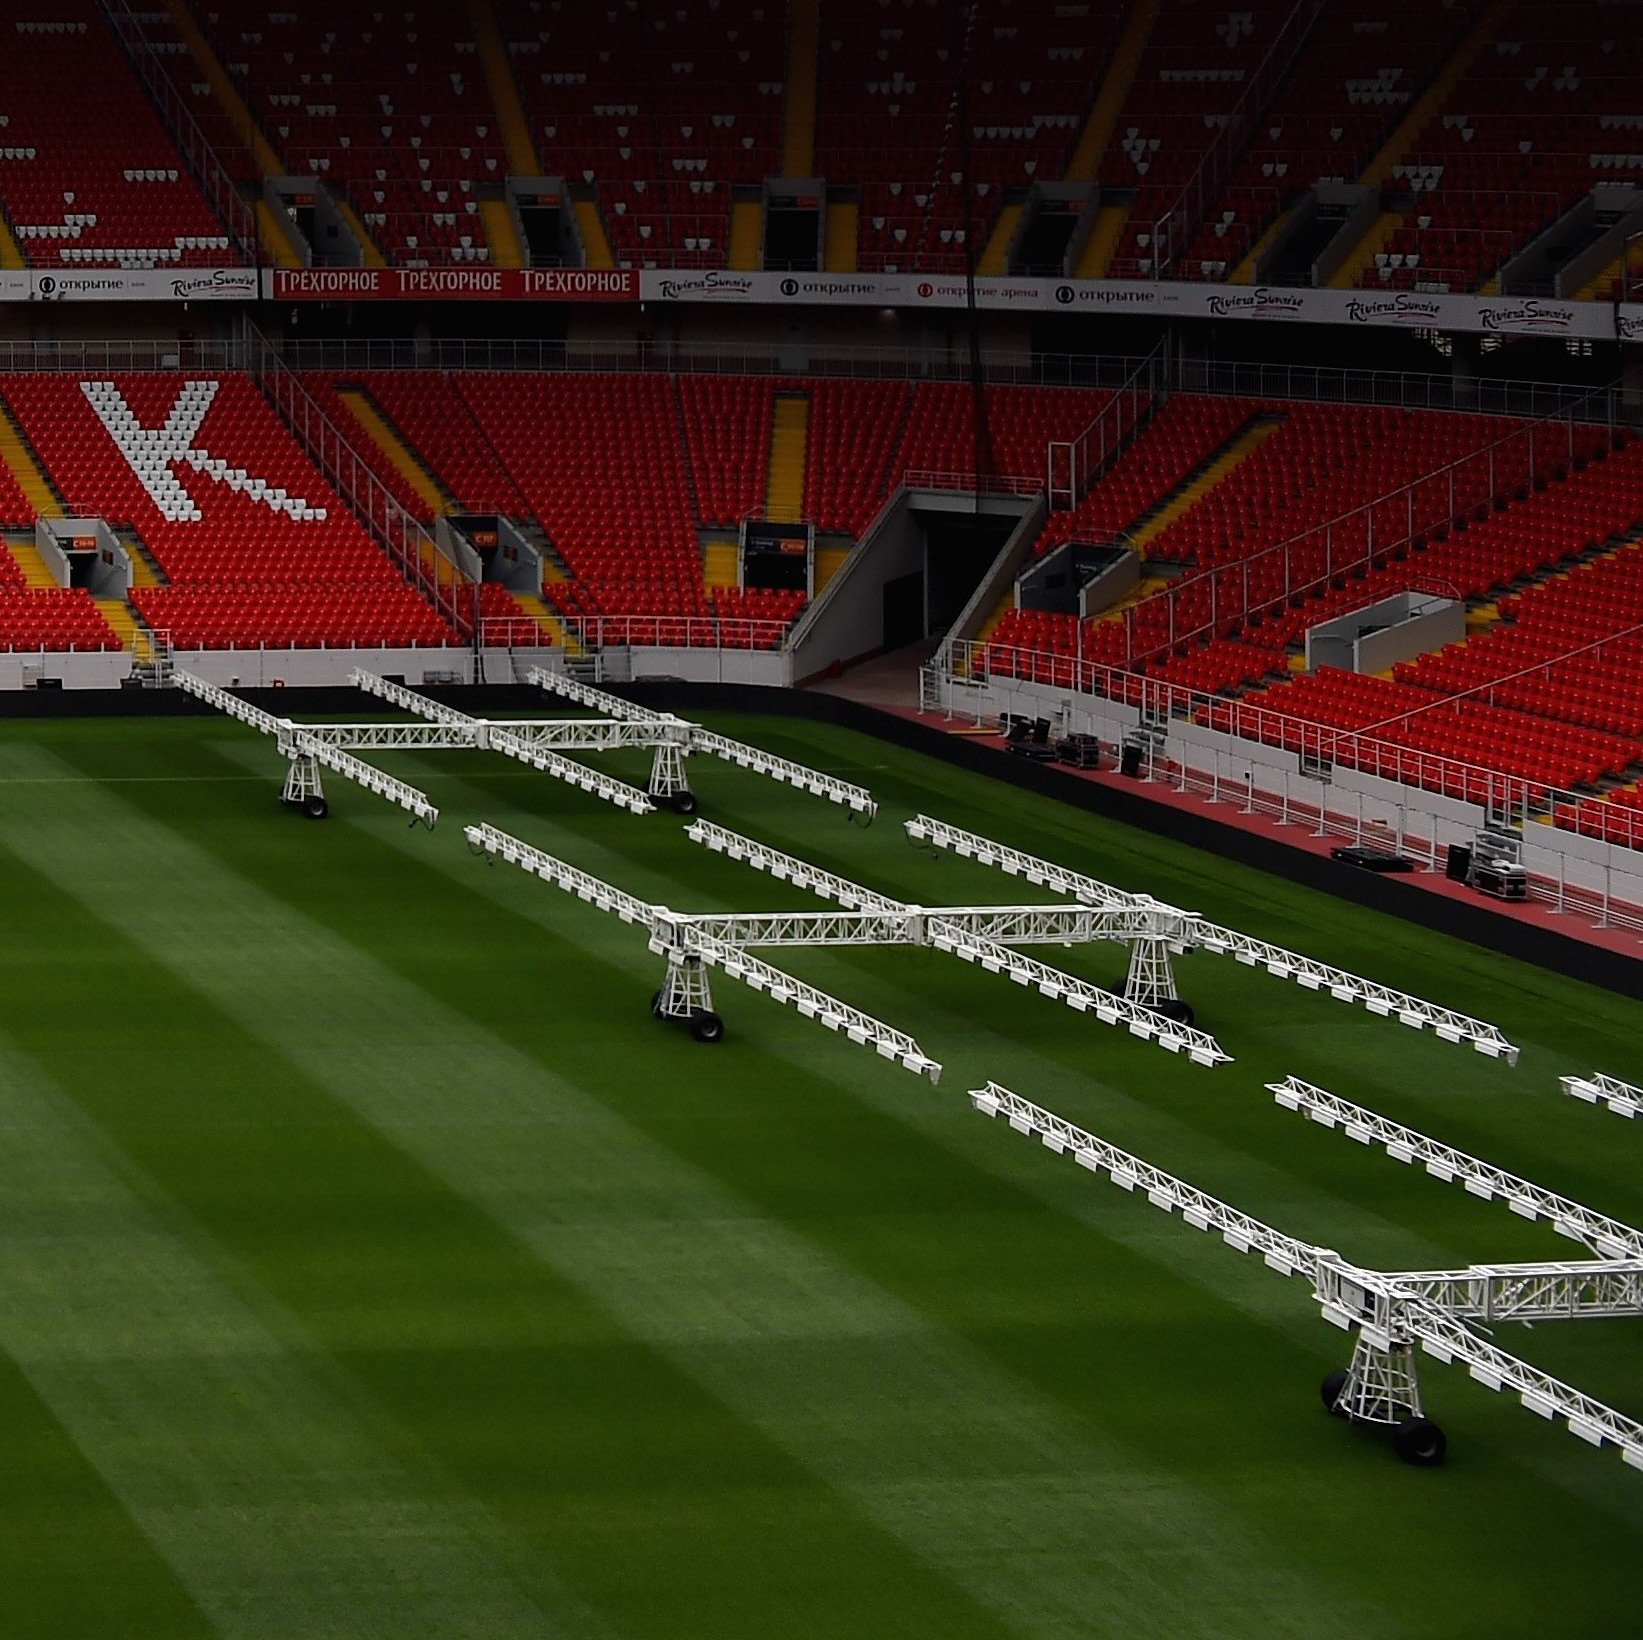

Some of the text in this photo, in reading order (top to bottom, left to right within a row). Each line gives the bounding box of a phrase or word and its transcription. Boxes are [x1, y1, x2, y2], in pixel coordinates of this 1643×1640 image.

[59, 280, 124, 292] открытие
[170, 270, 256, 297] Riviera Sunrise
[659, 272, 753, 298] Riviera Sunrise
[803, 283, 876, 297] открытие
[1002, 289, 1038, 300] арена
[1079, 290, 1155, 304] открытие
[1207, 288, 1304, 315] Riviera Sunrise
[1346, 294, 1441, 322] Riviera Sunrise
[1478, 301, 1574, 329] Riviera Sunrise
